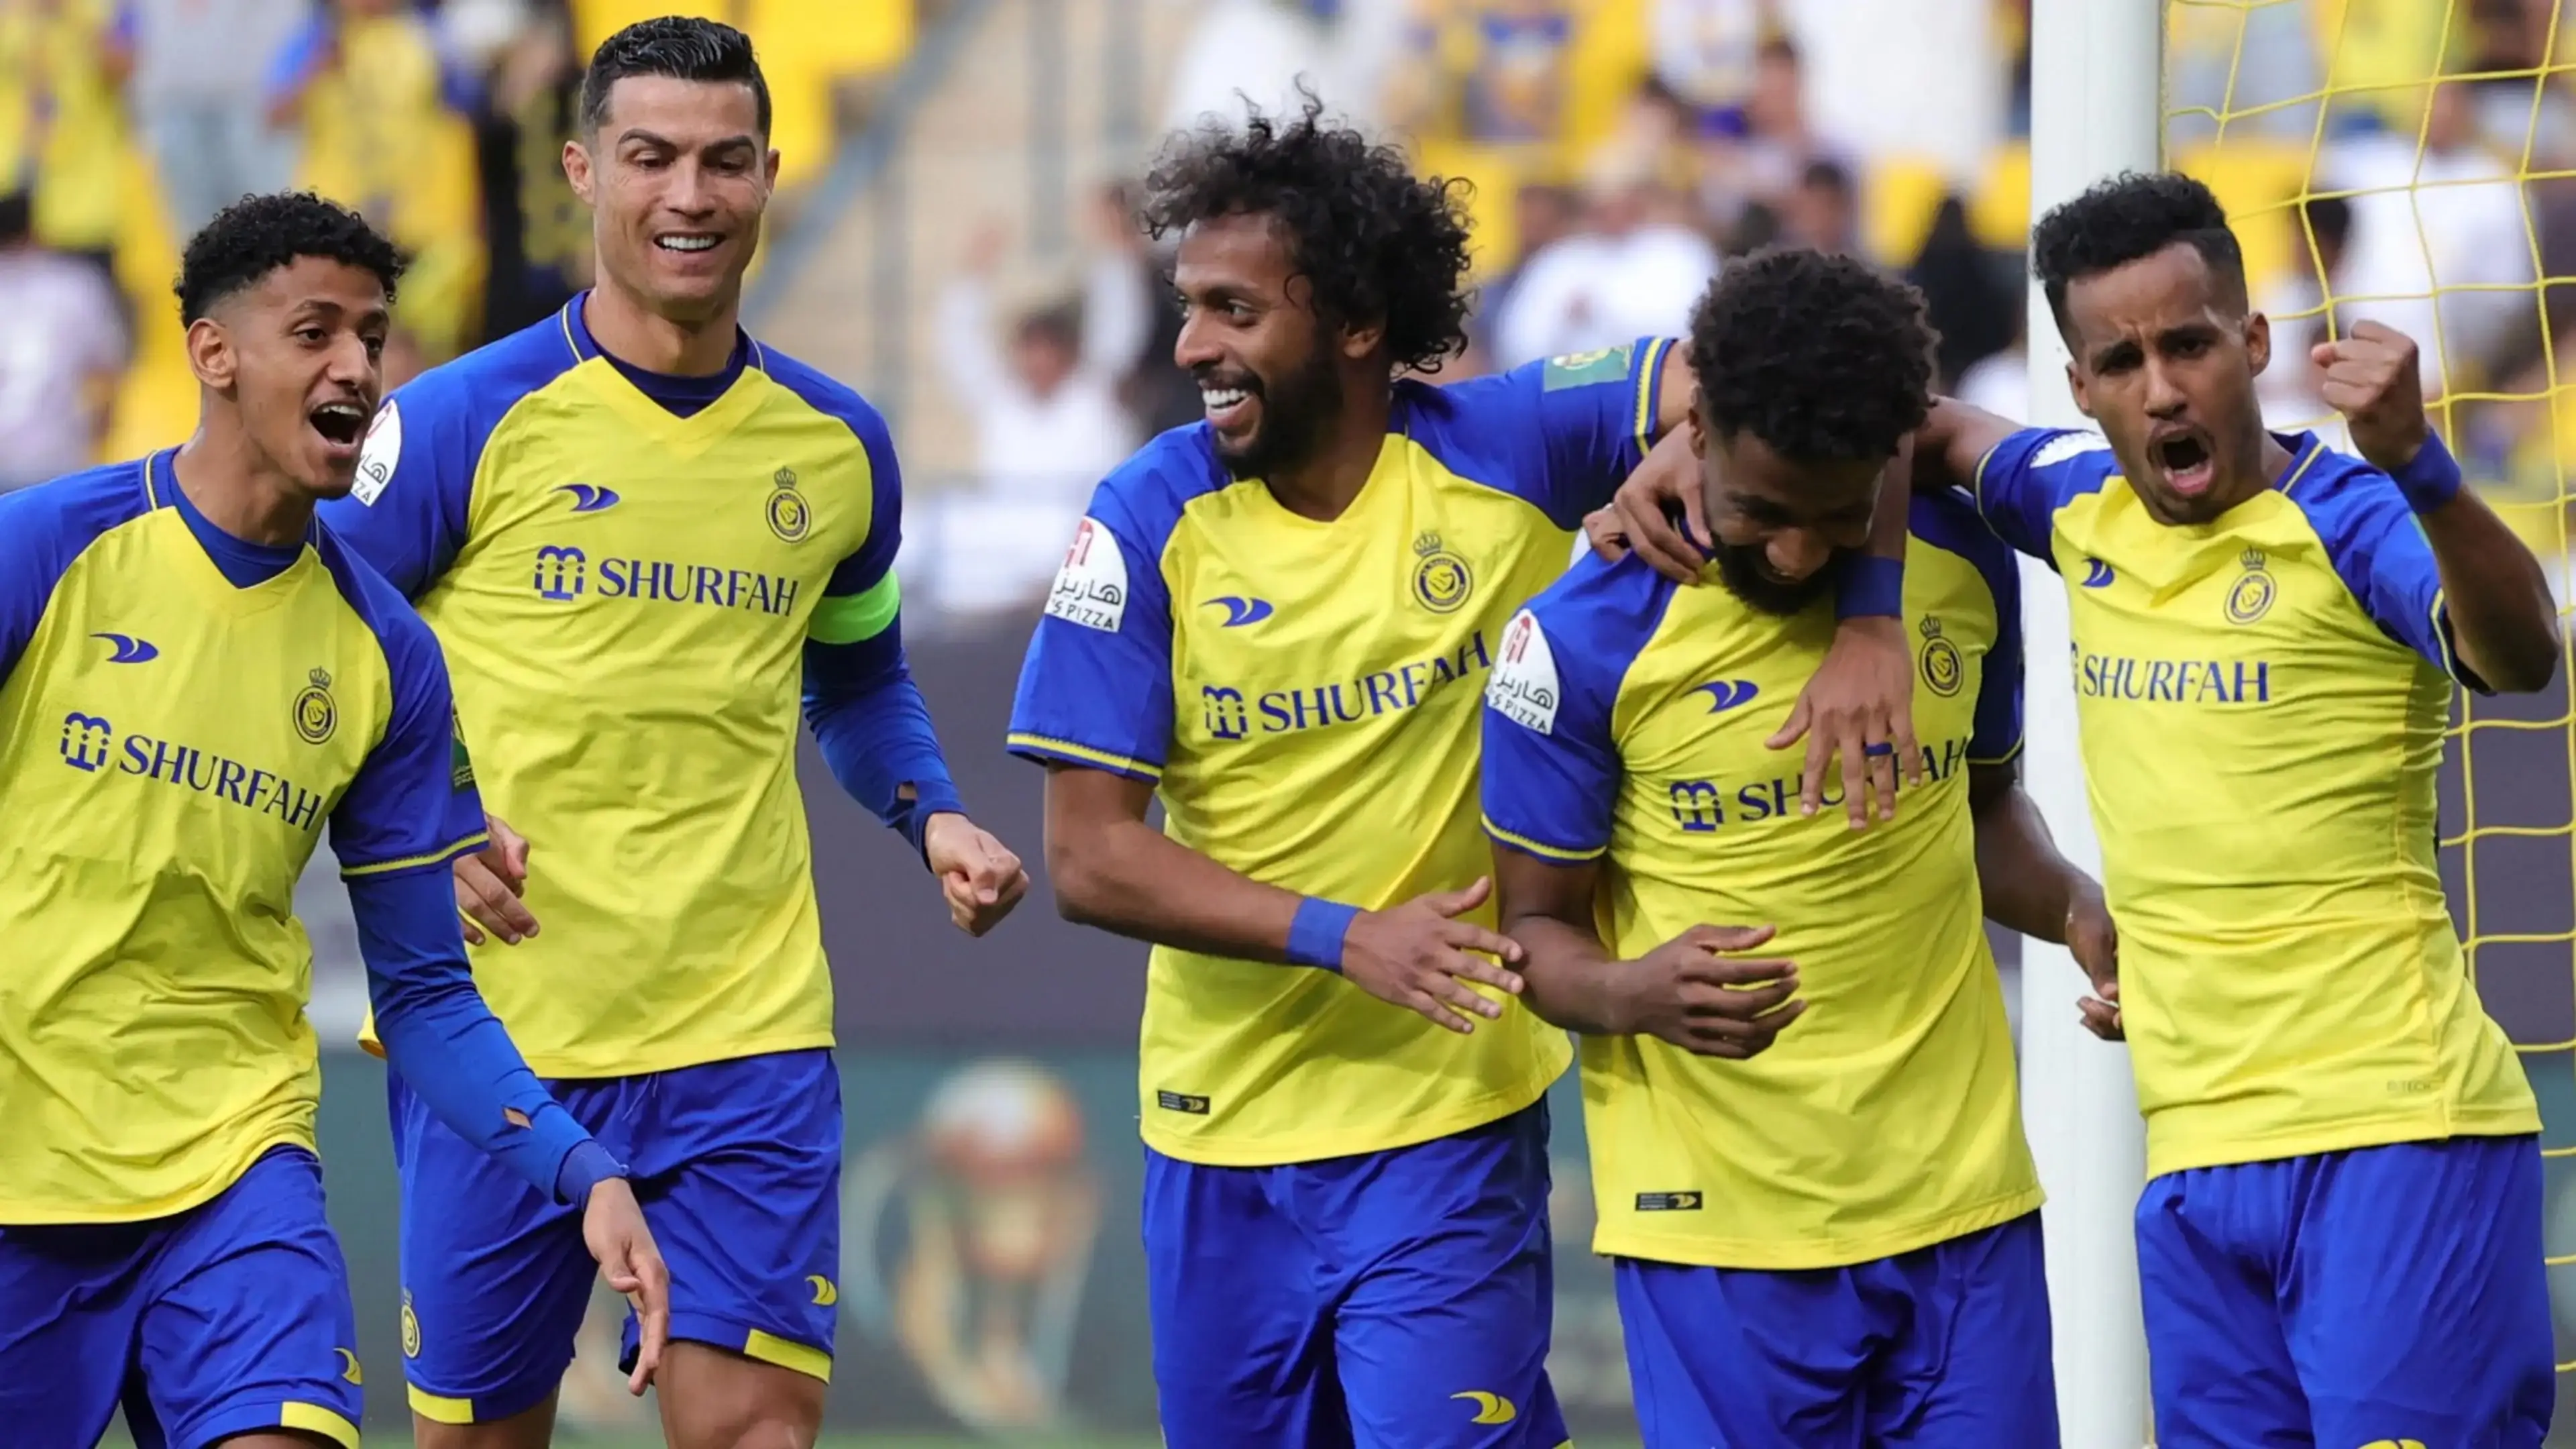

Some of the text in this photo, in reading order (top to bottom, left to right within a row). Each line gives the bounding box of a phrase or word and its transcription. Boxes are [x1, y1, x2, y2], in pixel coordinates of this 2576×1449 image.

[598, 557, 798, 616] SHURFAH
[1067, 604, 1115, 631] PIZZA
[1258, 631, 1491, 733] SHURFAH
[2084, 655, 2269, 702] SHURFAH
[1505, 699, 1548, 732] PIZZA
[119, 733, 322, 831] SHURFAH
